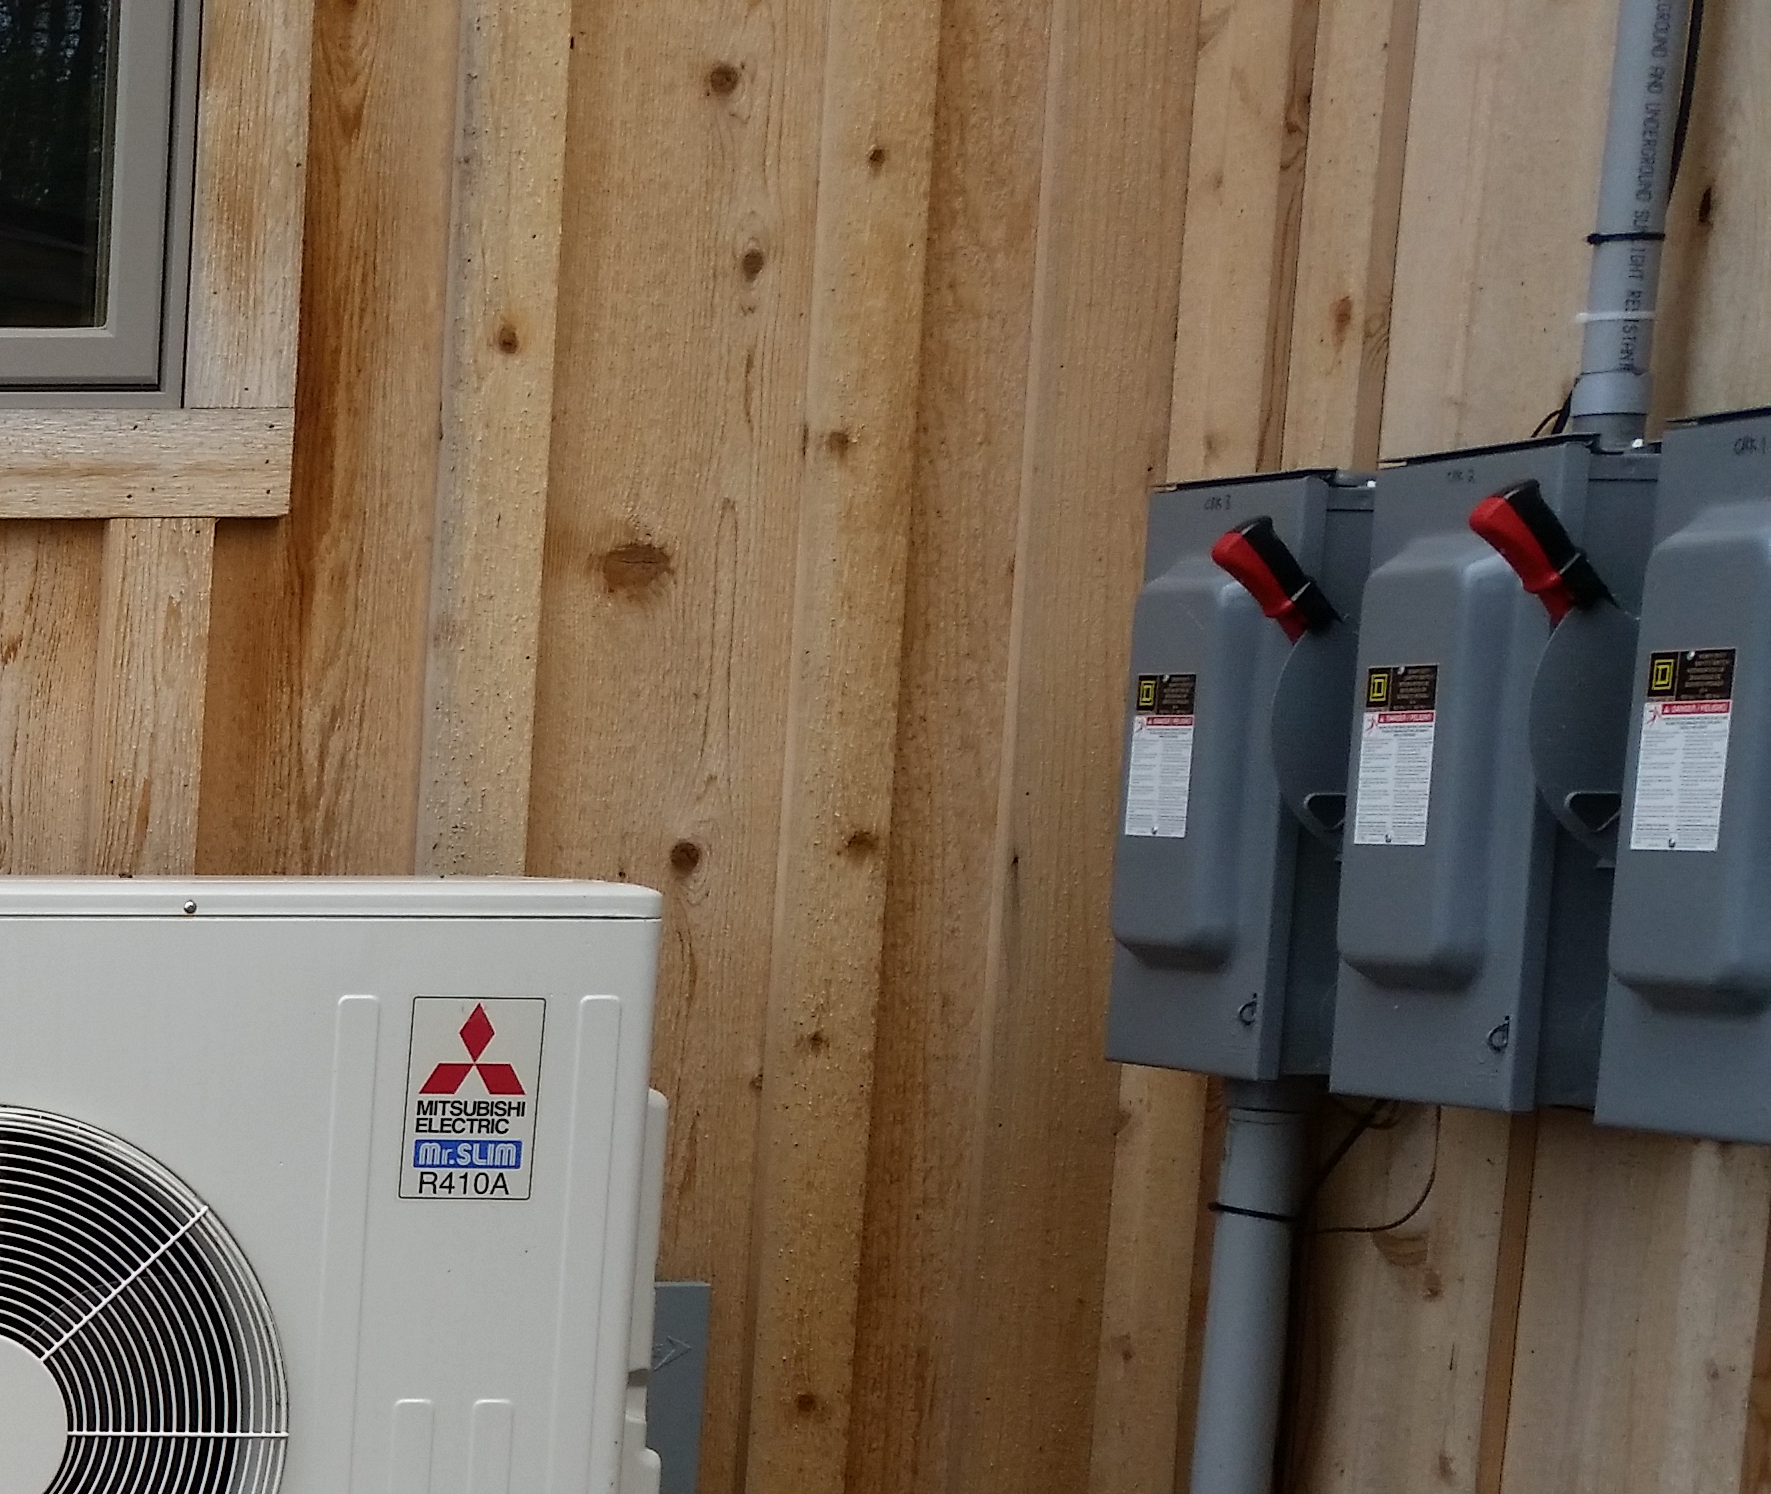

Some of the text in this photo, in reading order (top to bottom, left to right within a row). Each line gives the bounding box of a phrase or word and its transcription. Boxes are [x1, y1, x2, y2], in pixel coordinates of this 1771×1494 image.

[1628, 209, 1650, 279] SUIGHT
[416, 1100, 526, 1117] MITSUBISHI
[415, 1118, 510, 1135] ELECTRIC
[418, 1172, 510, 1196] R410A
